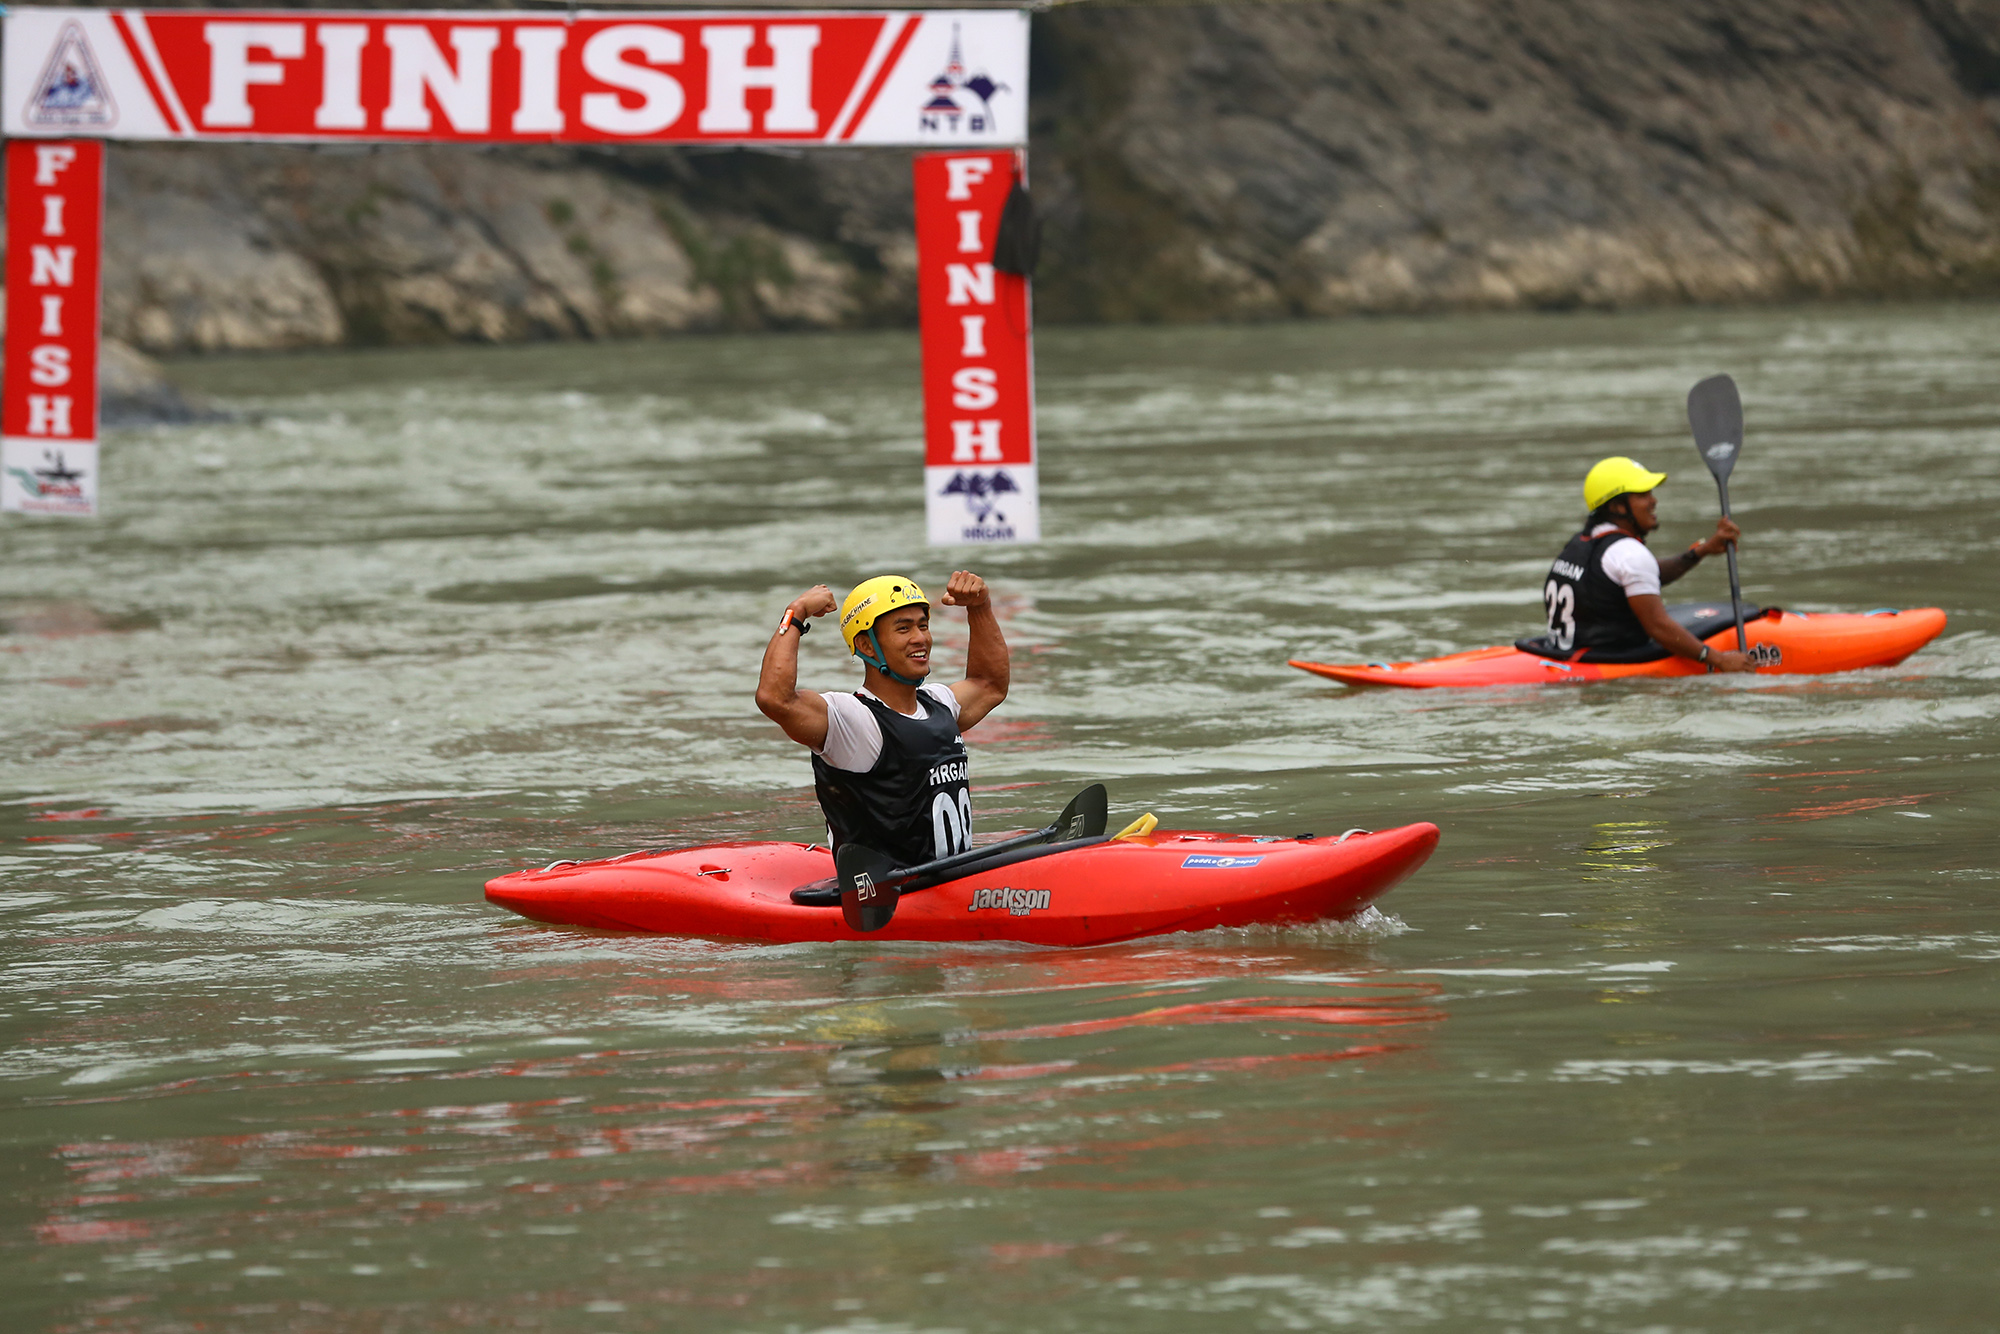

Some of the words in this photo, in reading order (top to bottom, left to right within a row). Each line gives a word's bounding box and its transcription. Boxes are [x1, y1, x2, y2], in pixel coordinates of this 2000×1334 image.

[202, 22, 821, 136] FINISH
[919, 112, 985, 134] NTB
[27, 145, 77, 436] FINISH
[945, 157, 1004, 463] FINISH
[1545, 579, 1576, 651] 23
[968, 887, 1051, 912] jackson
